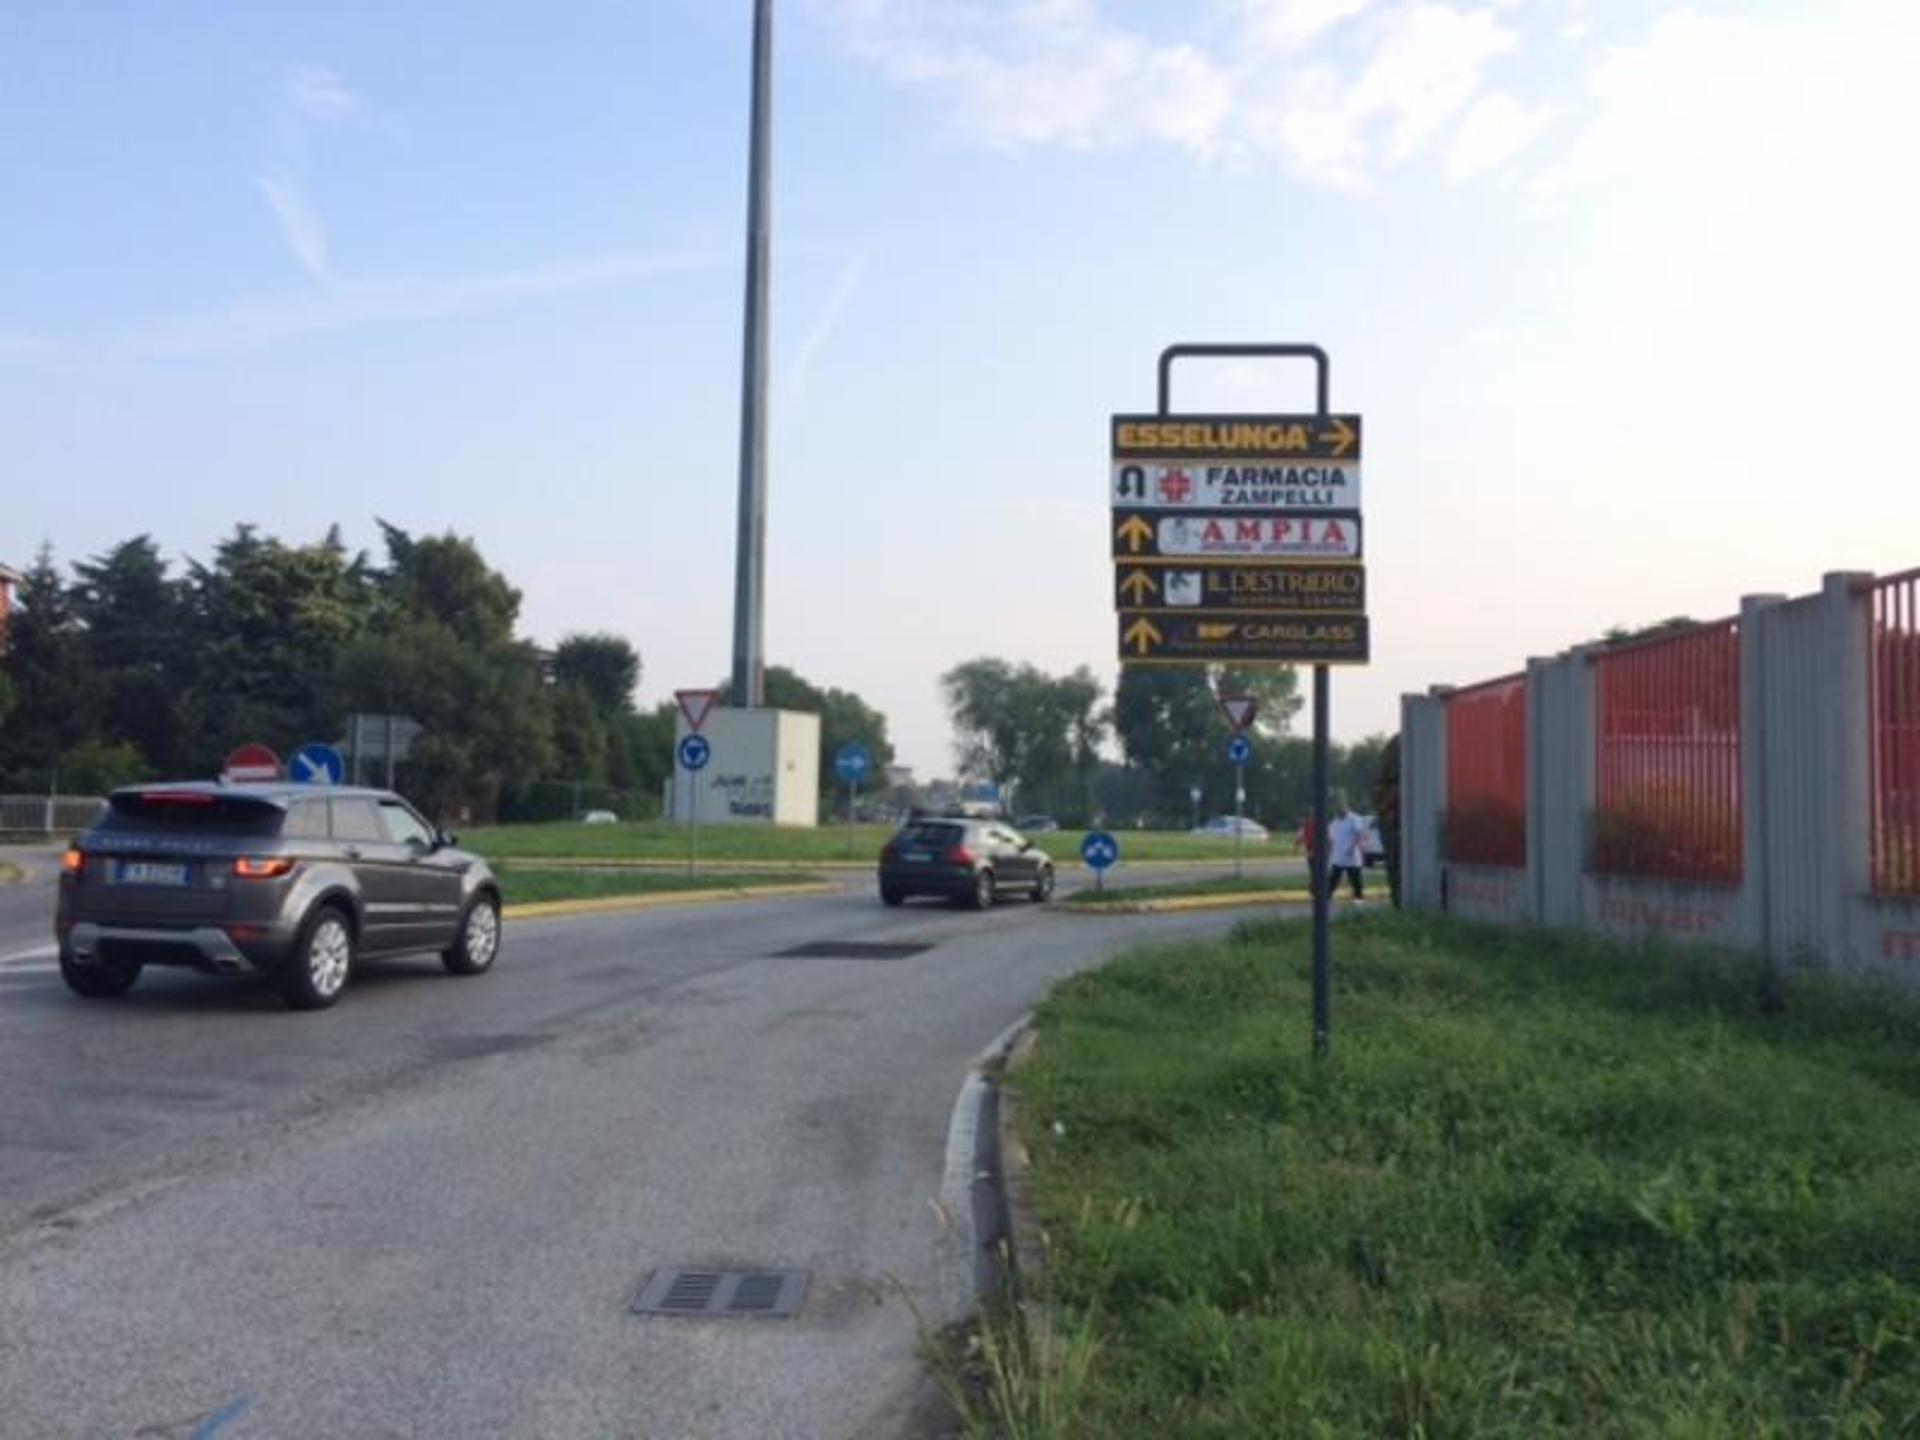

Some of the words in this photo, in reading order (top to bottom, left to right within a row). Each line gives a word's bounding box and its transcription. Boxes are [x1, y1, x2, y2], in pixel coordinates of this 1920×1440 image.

[1118, 423, 1308, 449] ESSELUNGA
[1207, 467, 1345, 487] FARMACIA
[1220, 488, 1333, 506] ZAMPELLI
[1202, 518, 1345, 542] AMPIA
[1241, 624, 1357, 641] CARGLASS
